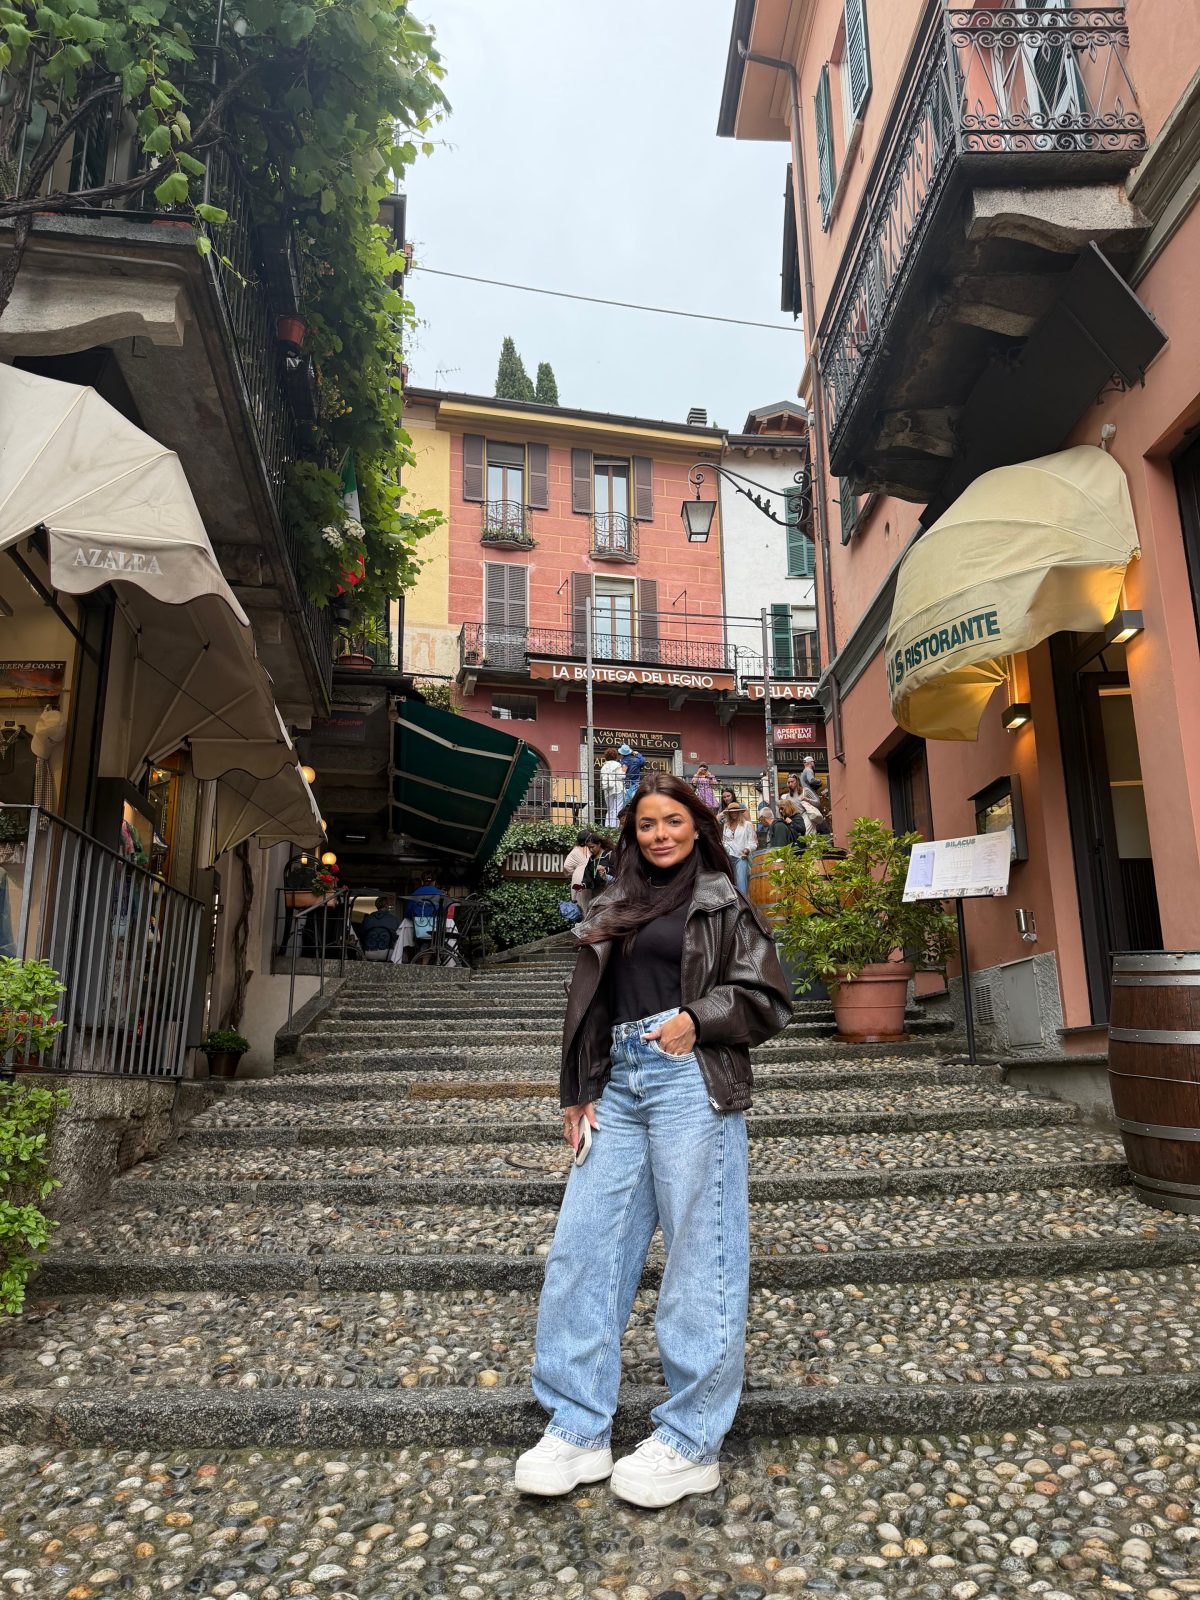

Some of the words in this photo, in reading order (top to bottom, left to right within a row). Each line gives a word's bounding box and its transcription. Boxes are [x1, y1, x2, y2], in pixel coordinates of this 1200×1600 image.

[72, 547, 164, 576] AZALEA
[904, 610, 1001, 672] RISTORANTE
[552, 665, 570, 679] LA
[574, 667, 638, 683] BOTTEGA
[641, 671, 665, 684] DEL
[668, 673, 713, 688] LEGNO
[584, 735, 625, 746] LAVORI
[627, 738, 638, 746] IN
[641, 739, 679, 749] LEGNO
[776, 727, 812, 735] APERITIVI
[776, 751, 825, 761] INDUSTRIA
[505, 851, 564, 873] TRATTORI
